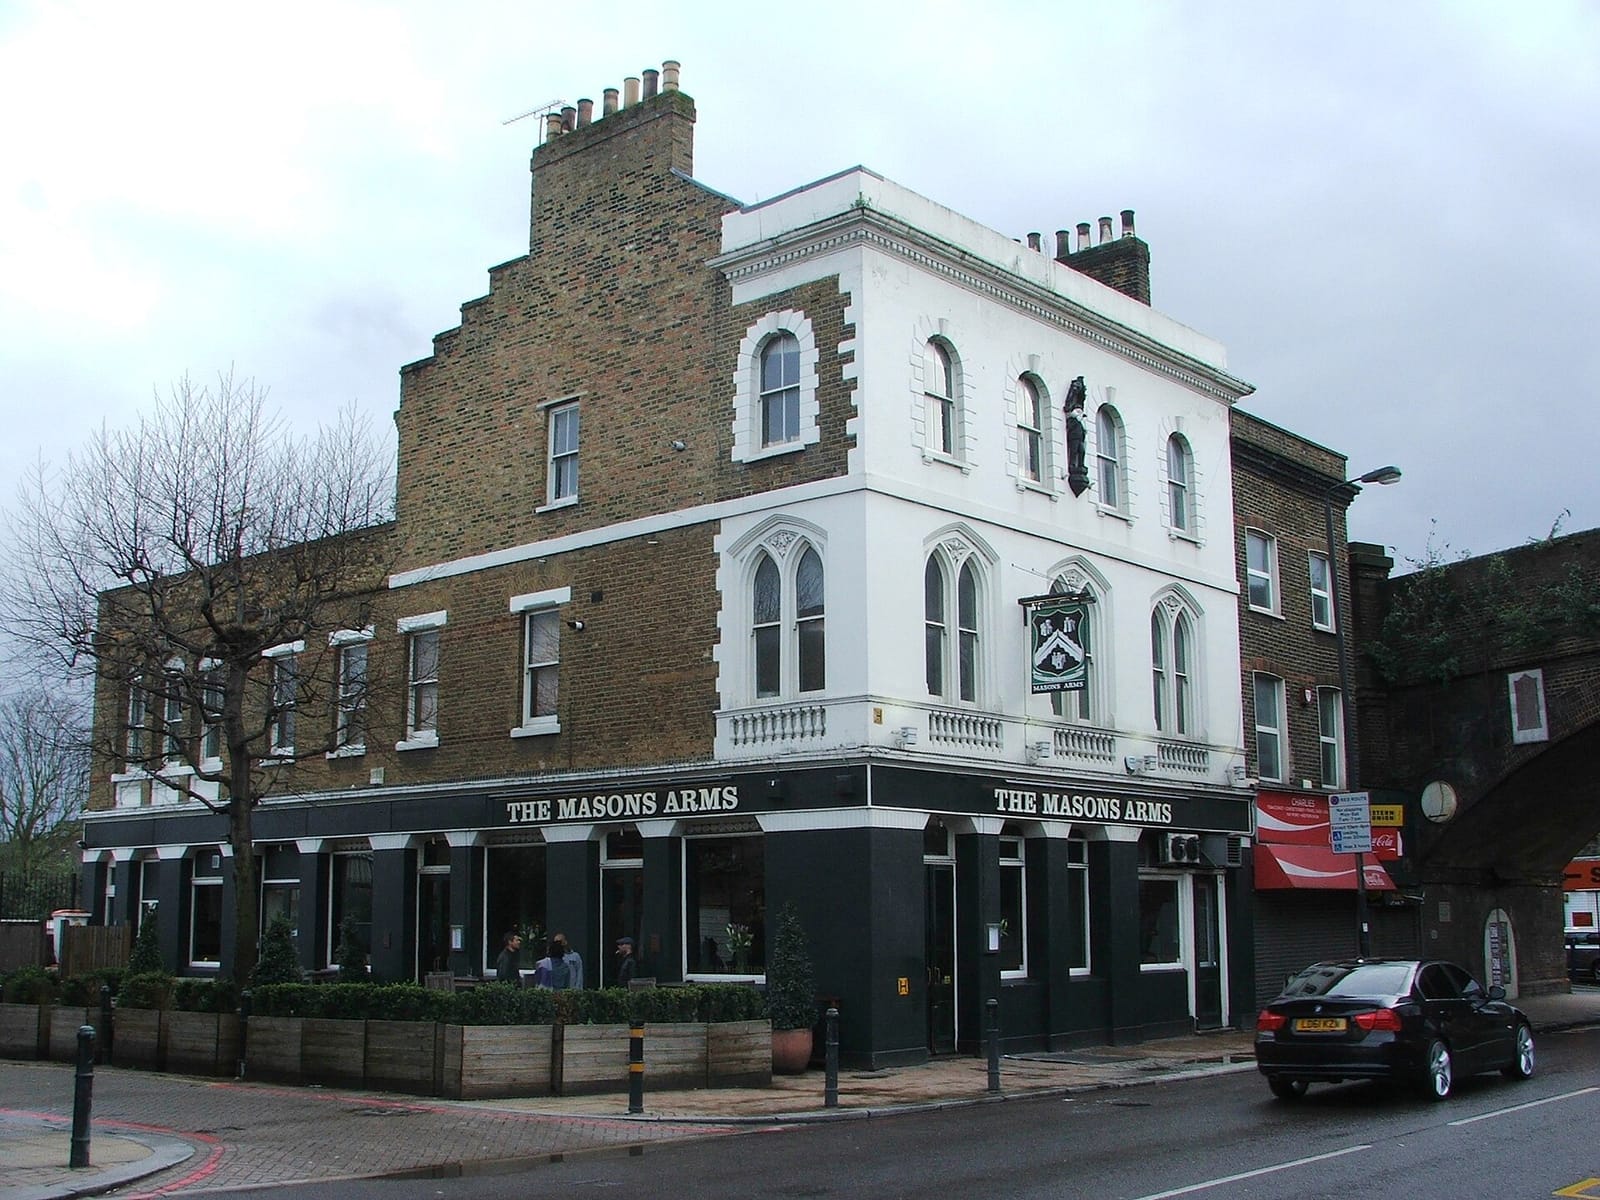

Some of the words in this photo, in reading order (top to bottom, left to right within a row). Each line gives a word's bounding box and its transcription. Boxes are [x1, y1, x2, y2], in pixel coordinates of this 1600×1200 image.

[1064, 681, 1084, 689] ARMS
[507, 800, 551, 823] THE
[557, 792, 657, 820] MASONS
[663, 786, 738, 814] ARMS
[994, 788, 1037, 814] THE
[1042, 793, 1121, 820] MASONS
[1124, 800, 1172, 824] ARMS
